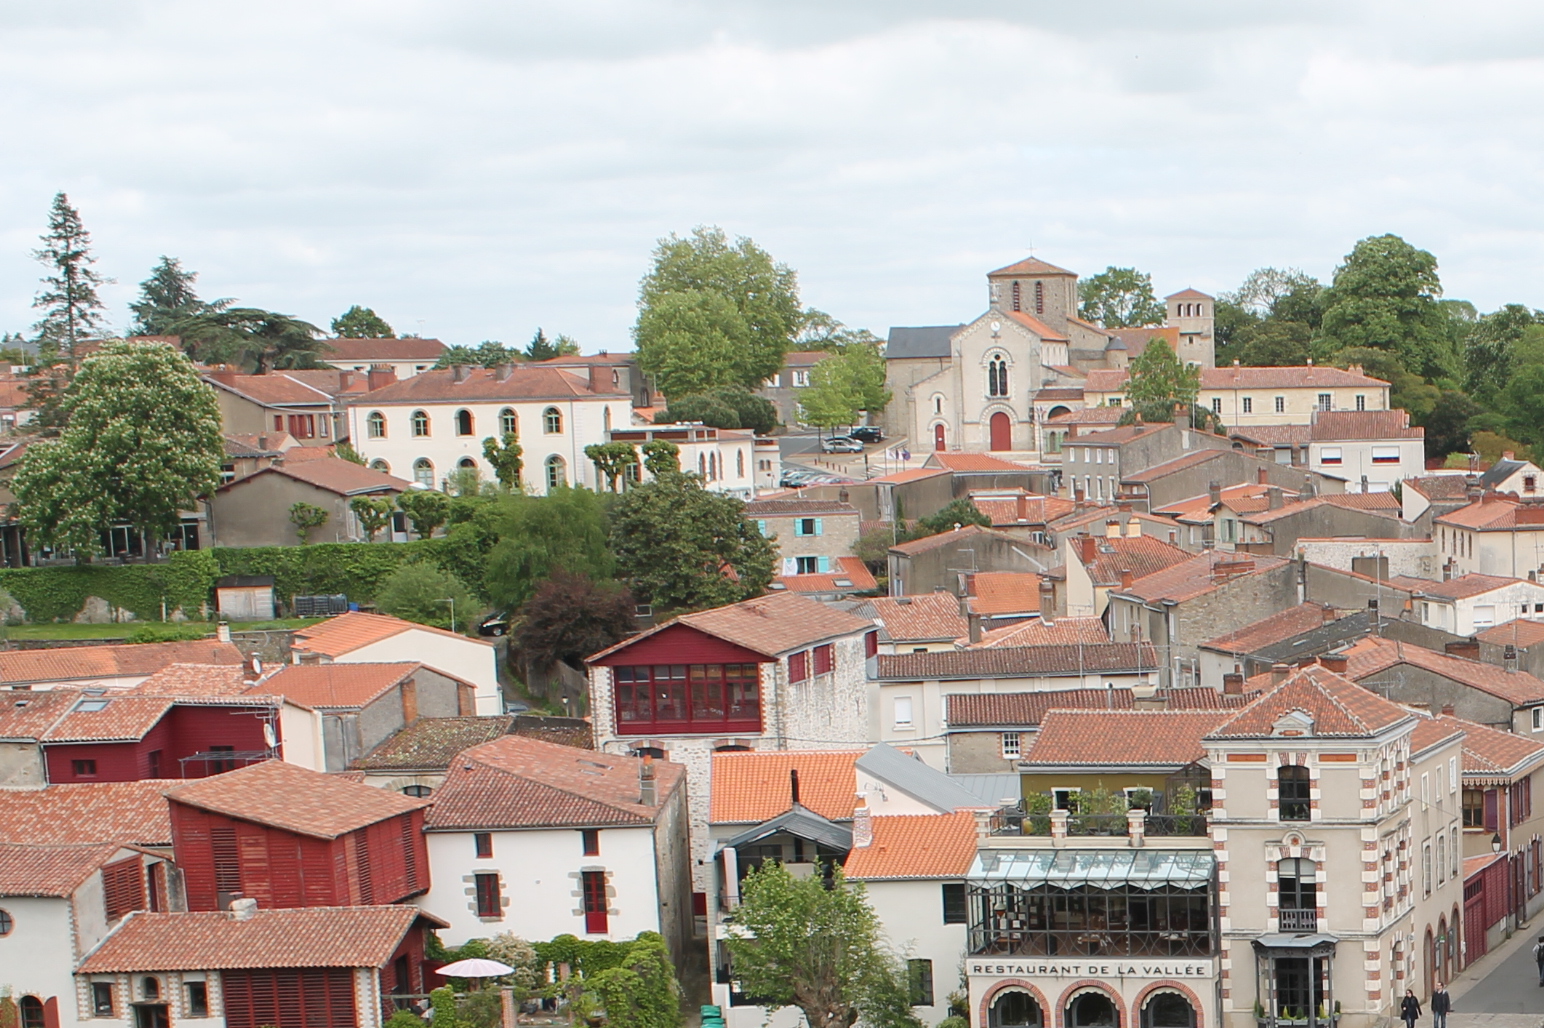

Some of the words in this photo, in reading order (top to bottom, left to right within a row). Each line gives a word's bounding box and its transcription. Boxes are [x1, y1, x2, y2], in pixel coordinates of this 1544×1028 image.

[973, 965, 1081, 975] RESTAURANT
[1088, 965, 1109, 975] DE
[1117, 966, 1137, 975] LA
[1142, 963, 1205, 975] VALLÉE
